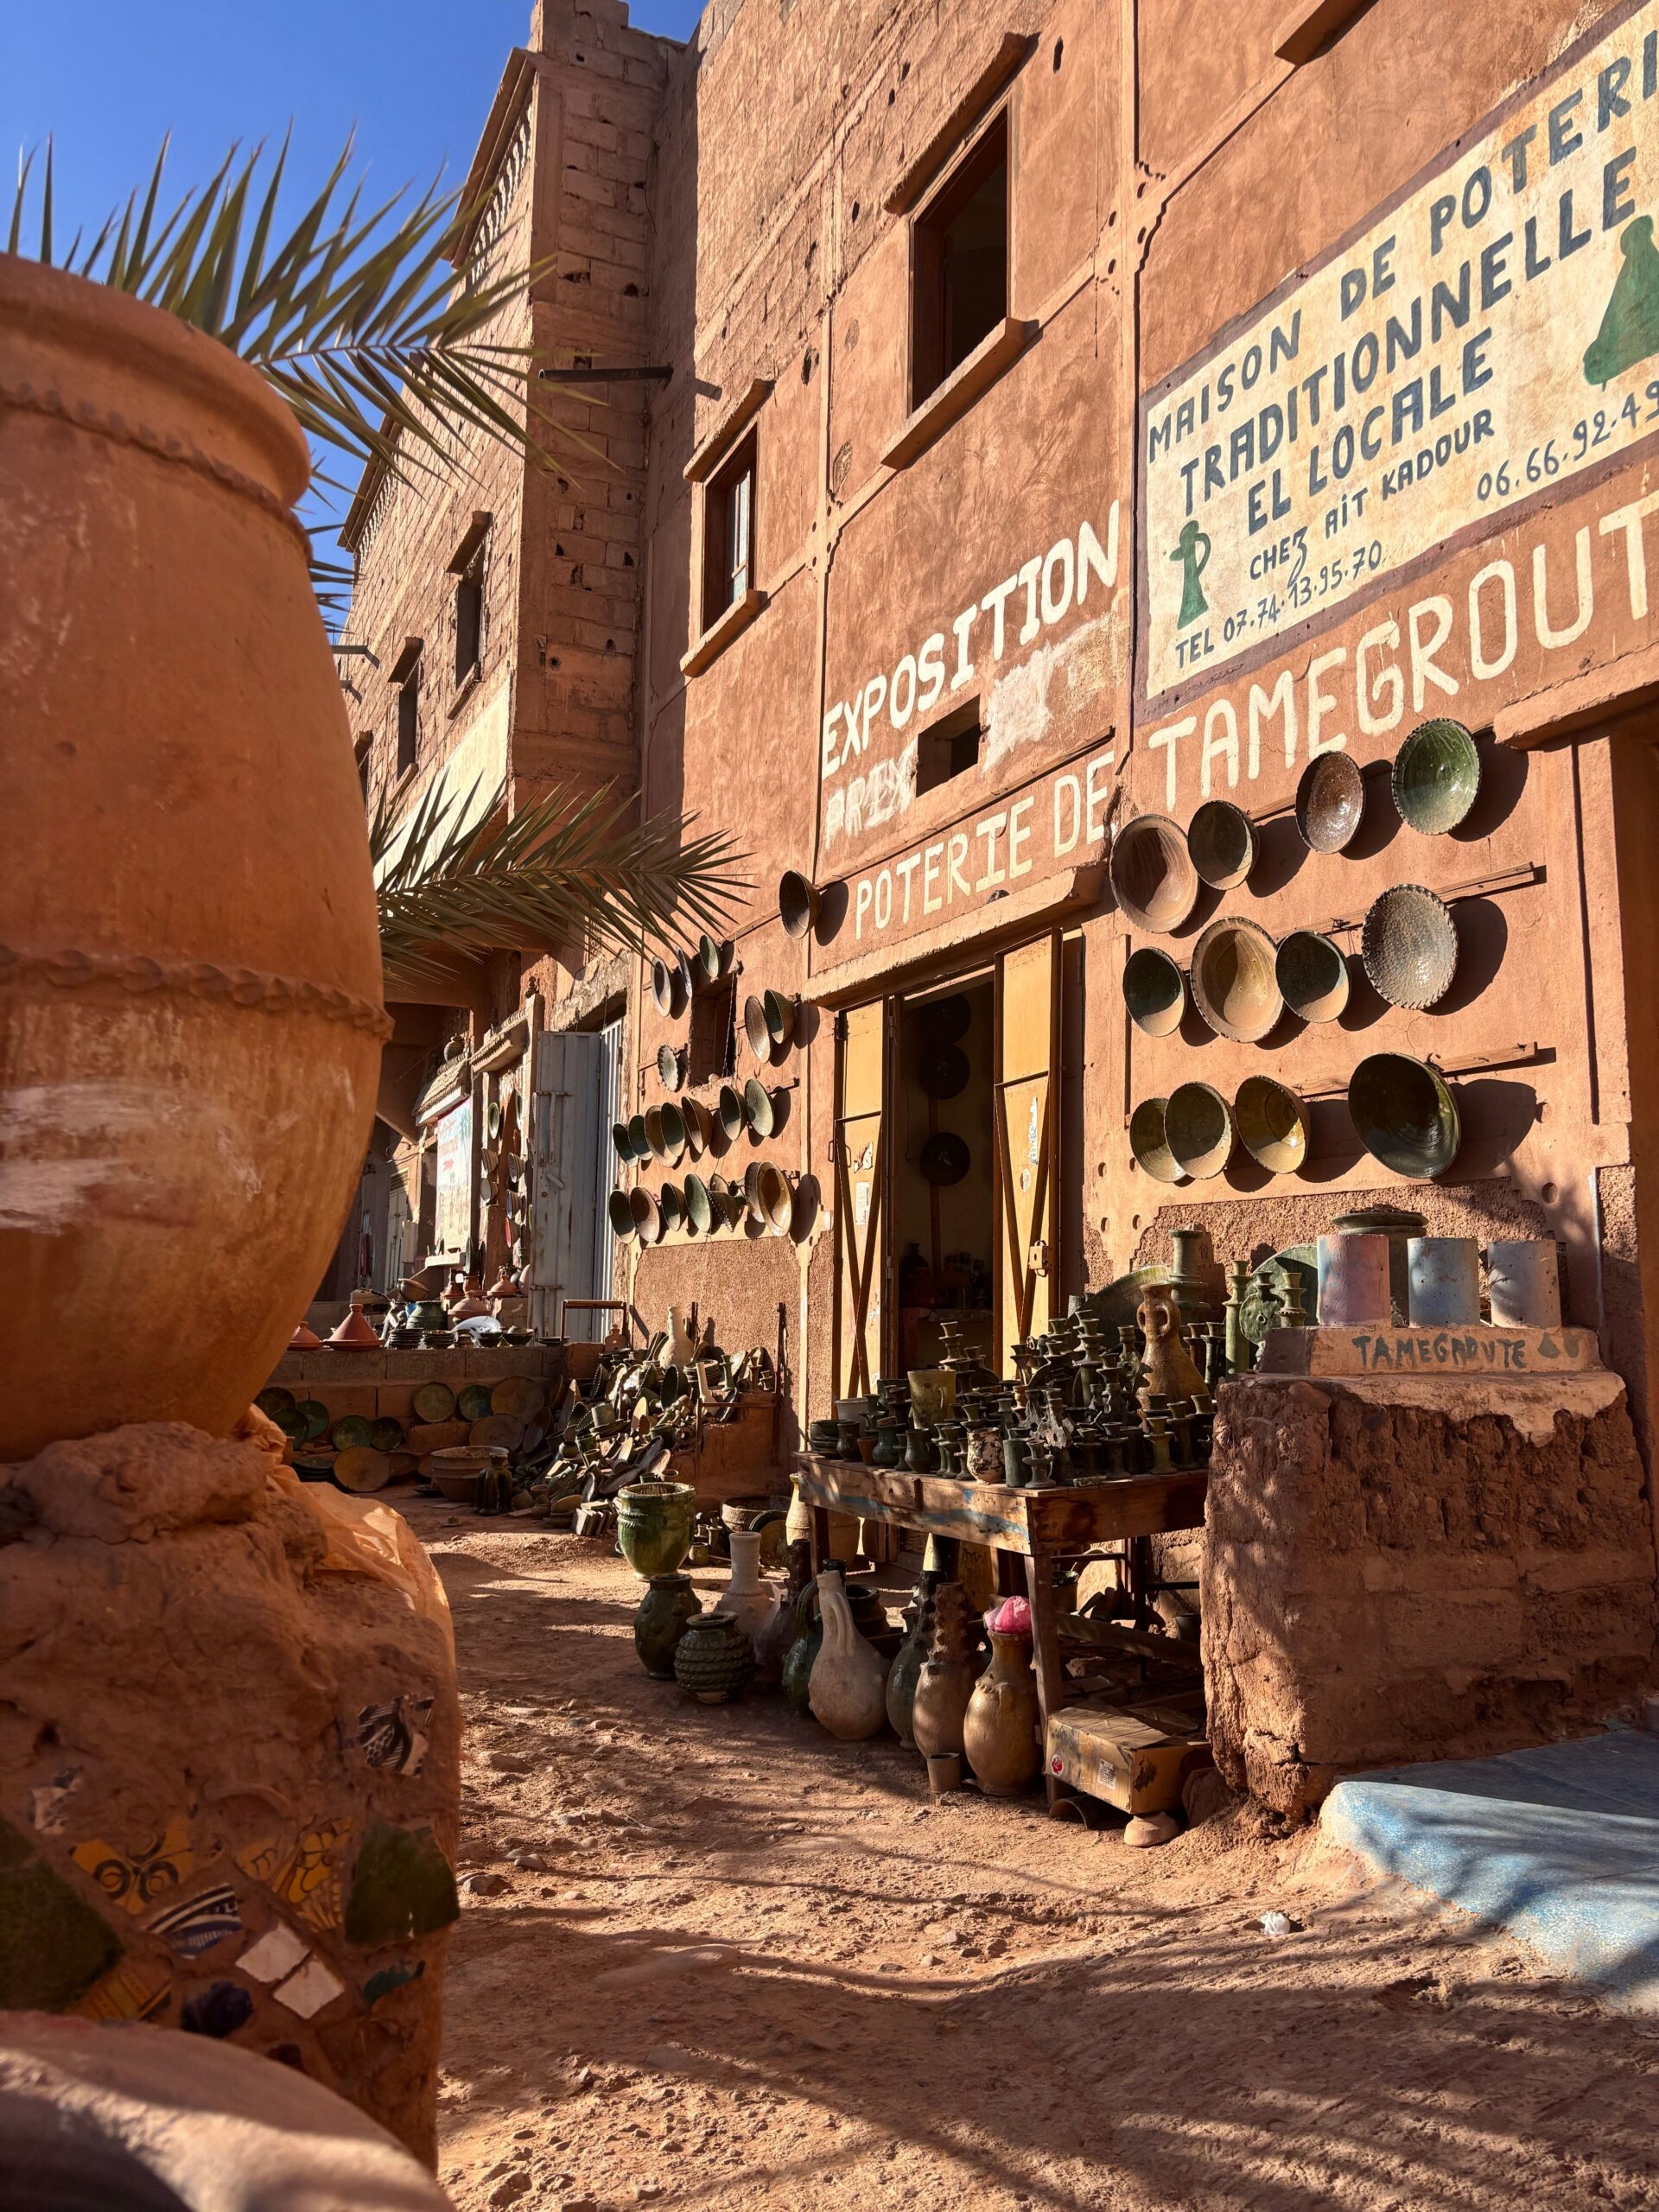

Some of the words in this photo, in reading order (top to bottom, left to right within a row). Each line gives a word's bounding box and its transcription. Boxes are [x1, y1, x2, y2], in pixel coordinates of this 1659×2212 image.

[1149, 308, 1301, 463] MAISON
[1341, 235, 1395, 321] DE
[1430, 29, 1658, 257] POTERI
[1180, 146, 1637, 516] TRADITIONNELLE
[1248, 468, 1292, 536] EL
[1309, 327, 1492, 497] LOCALE
[1382, 409, 1495, 500] KADOUR
[822, 499, 1119, 780] EXPOSITION
[855, 795, 1035, 940] POTERIE
[1054, 750, 1116, 858] DE
[1148, 489, 1659, 813] TAMEGROUT
[1175, 628, 1214, 668] TEL
[1224, 539, 1382, 642] 07.74.13.95.70
